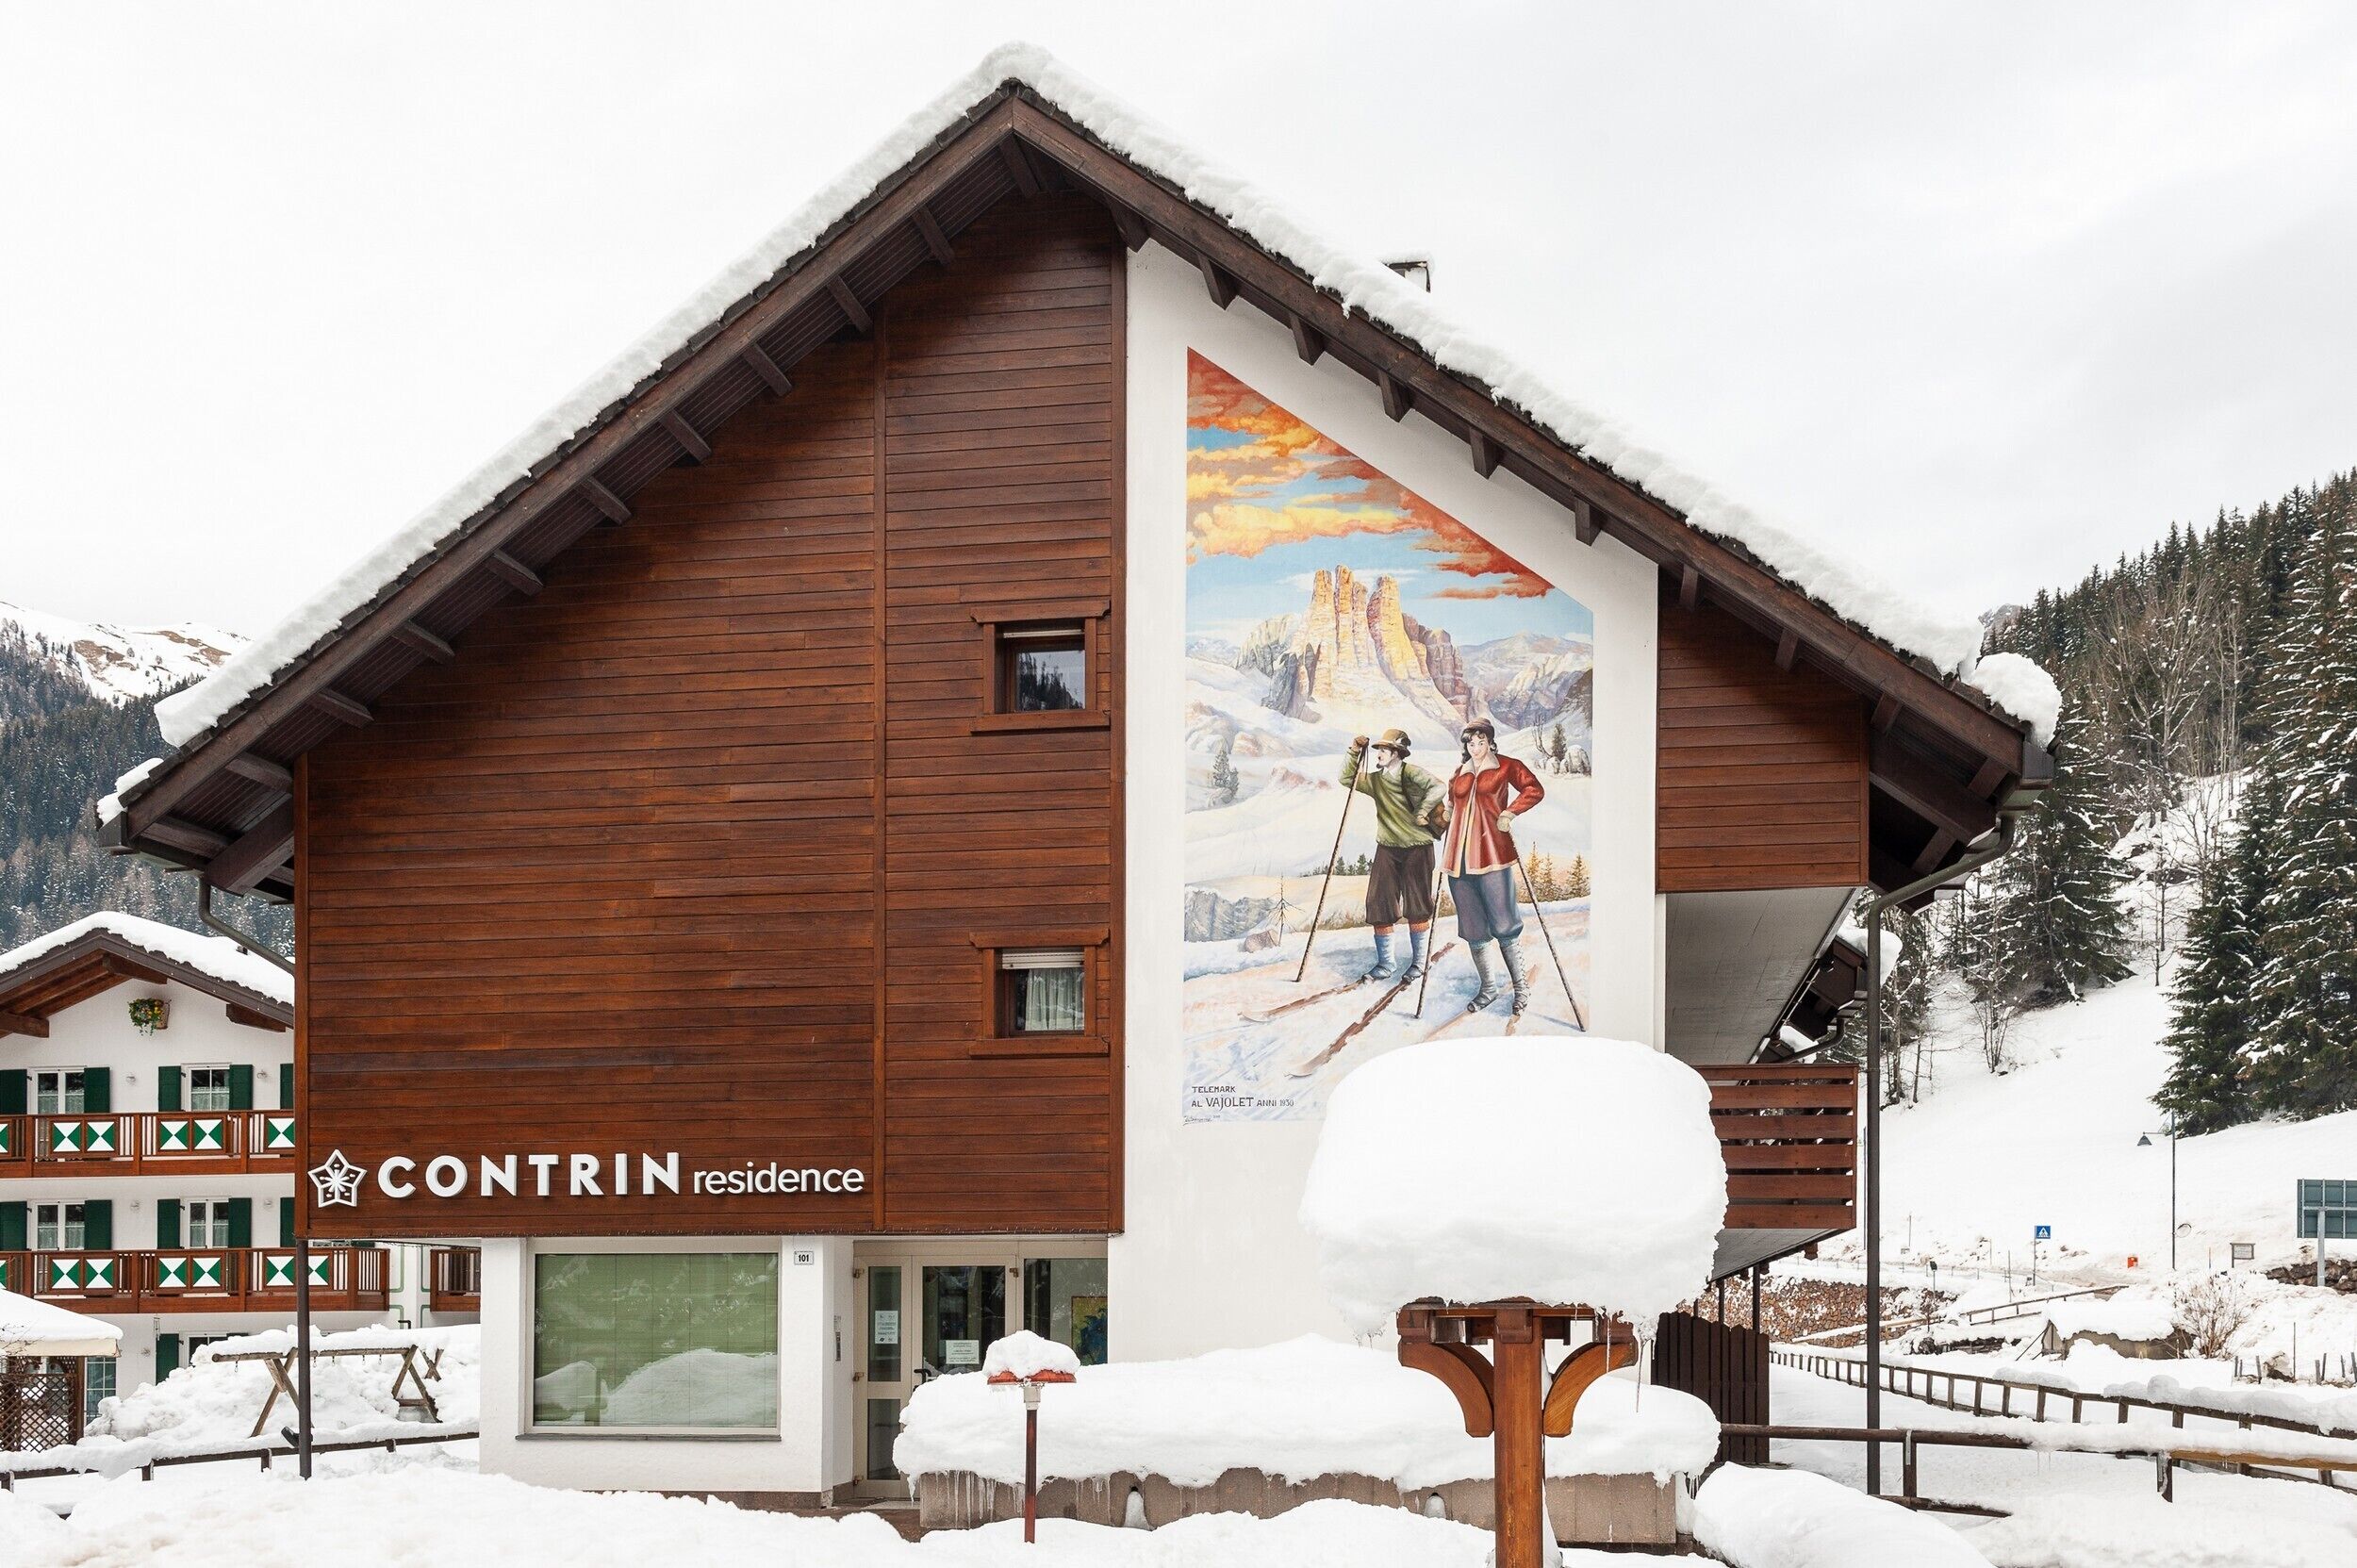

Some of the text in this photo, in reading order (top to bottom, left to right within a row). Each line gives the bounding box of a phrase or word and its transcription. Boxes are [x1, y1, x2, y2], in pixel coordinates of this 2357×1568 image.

[1191, 1085, 1236, 1094] TELEMARK
[1191, 1099, 1203, 1108] AL
[1256, 1098, 1277, 1108] ANNI
[378, 1151, 865, 1197] CONTRIN residence
[798, 1254, 809, 1263] 101
